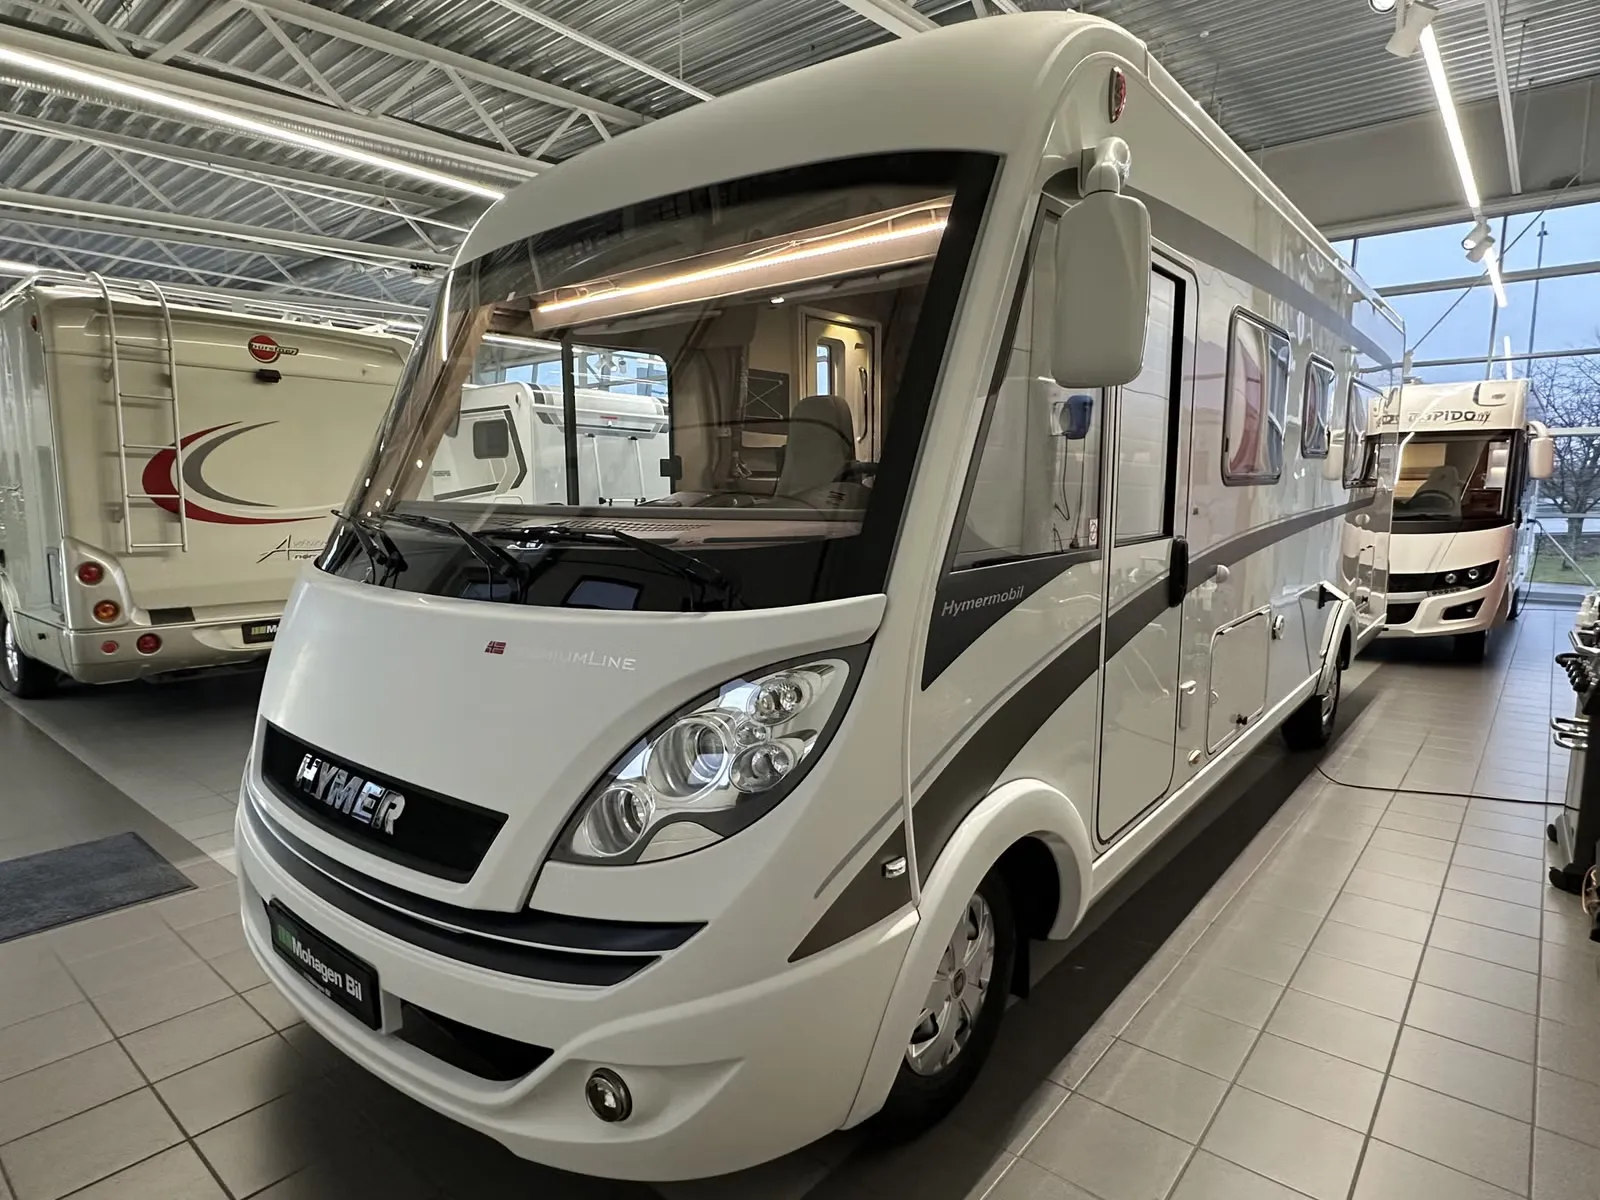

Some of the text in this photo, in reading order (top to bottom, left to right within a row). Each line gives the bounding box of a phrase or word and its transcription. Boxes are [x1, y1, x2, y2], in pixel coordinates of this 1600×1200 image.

[941, 585, 1024, 617] Hymermobil
[295, 753, 406, 836] HYMER
[291, 935, 343, 988] Mohagen
[345, 973, 363, 1002] Bil
